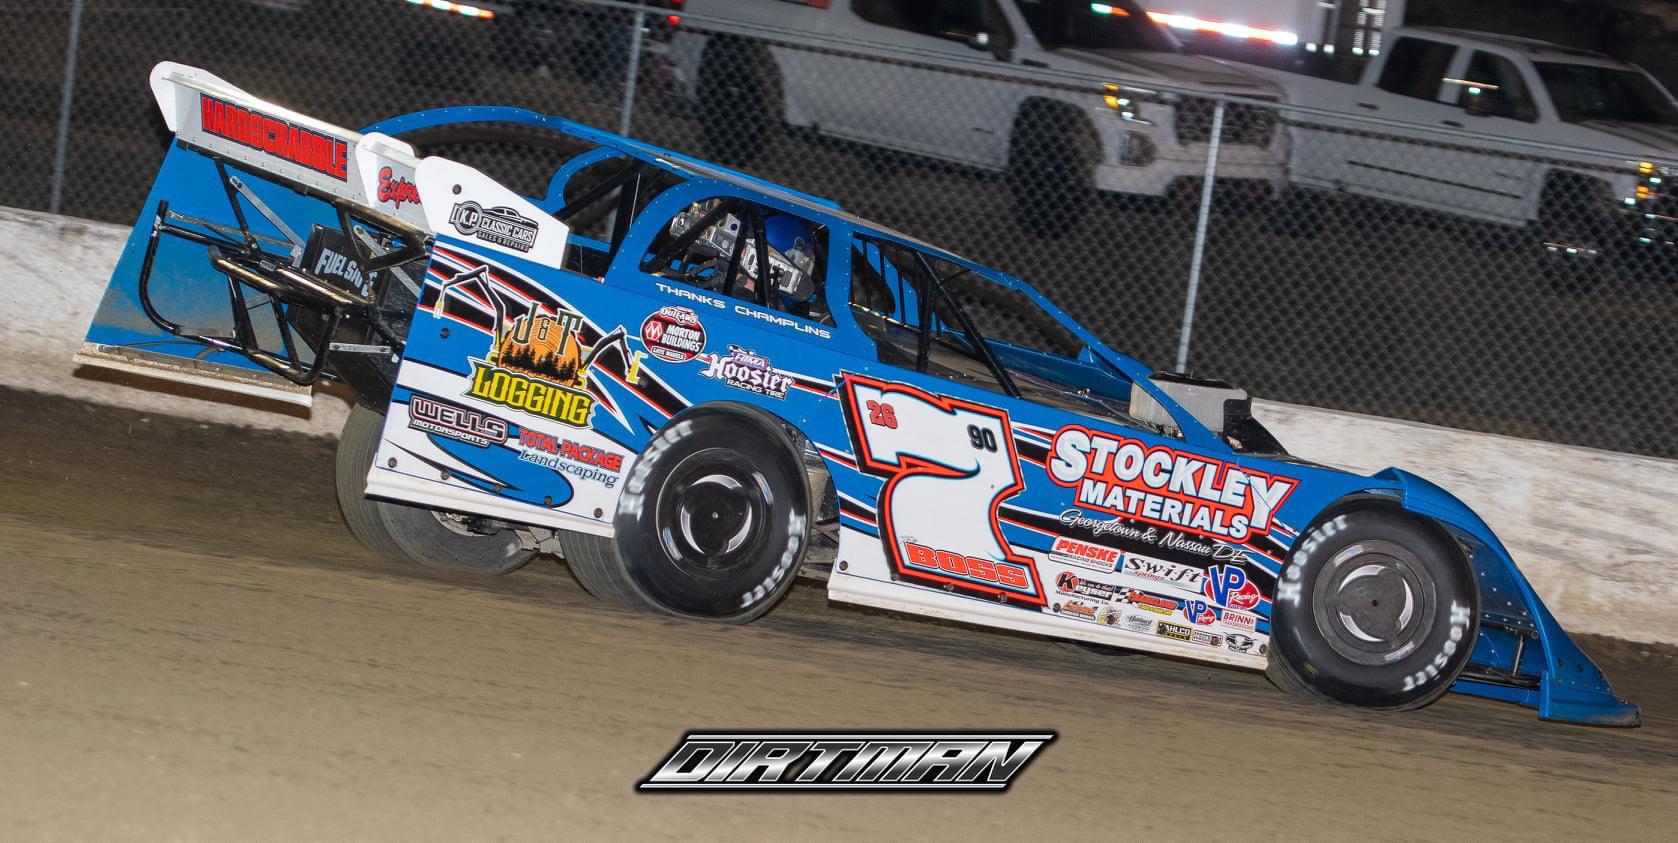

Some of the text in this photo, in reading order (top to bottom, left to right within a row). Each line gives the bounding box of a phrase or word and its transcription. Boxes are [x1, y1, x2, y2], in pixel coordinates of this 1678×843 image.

[200, 94, 348, 181] HARDSCRABBLE
[478, 231, 497, 242] SALES
[502, 238, 530, 251] REPAIRS
[481, 218, 533, 242] CLASSIC CARS
[314, 248, 347, 276] FUEL
[655, 282, 831, 339] THANKS CHAMPLINS
[661, 333, 703, 352] BUILDINGS
[666, 324, 700, 341] MORTON
[700, 353, 792, 392] Hoosier
[727, 379, 785, 399] RACING TIRE
[472, 366, 591, 426] LOGGING
[866, 400, 898, 429] 26
[411, 418, 490, 447] MOTORSPORTS
[412, 397, 507, 443] WELLS
[967, 424, 998, 453] 90
[519, 427, 624, 473] TOTAL PACKAGE
[519, 448, 619, 489] Landscaping
[836, 372, 1048, 606] 7
[1050, 428, 1292, 530] STOCKLEY
[1079, 478, 1250, 539] MATERIALS
[1055, 539, 1119, 563] PENSKE
[1059, 508, 1257, 565] Georgetown & Nassau DE
[904, 541, 1029, 589] BOSS
[1277, 514, 1348, 608] Hoosier
[1057, 572, 1112, 598] Keyser
[1208, 564, 1246, 607] VP
[1230, 591, 1258, 605] Racing
[1184, 599, 1208, 624] VP
[1403, 600, 1471, 692] Hoosier
